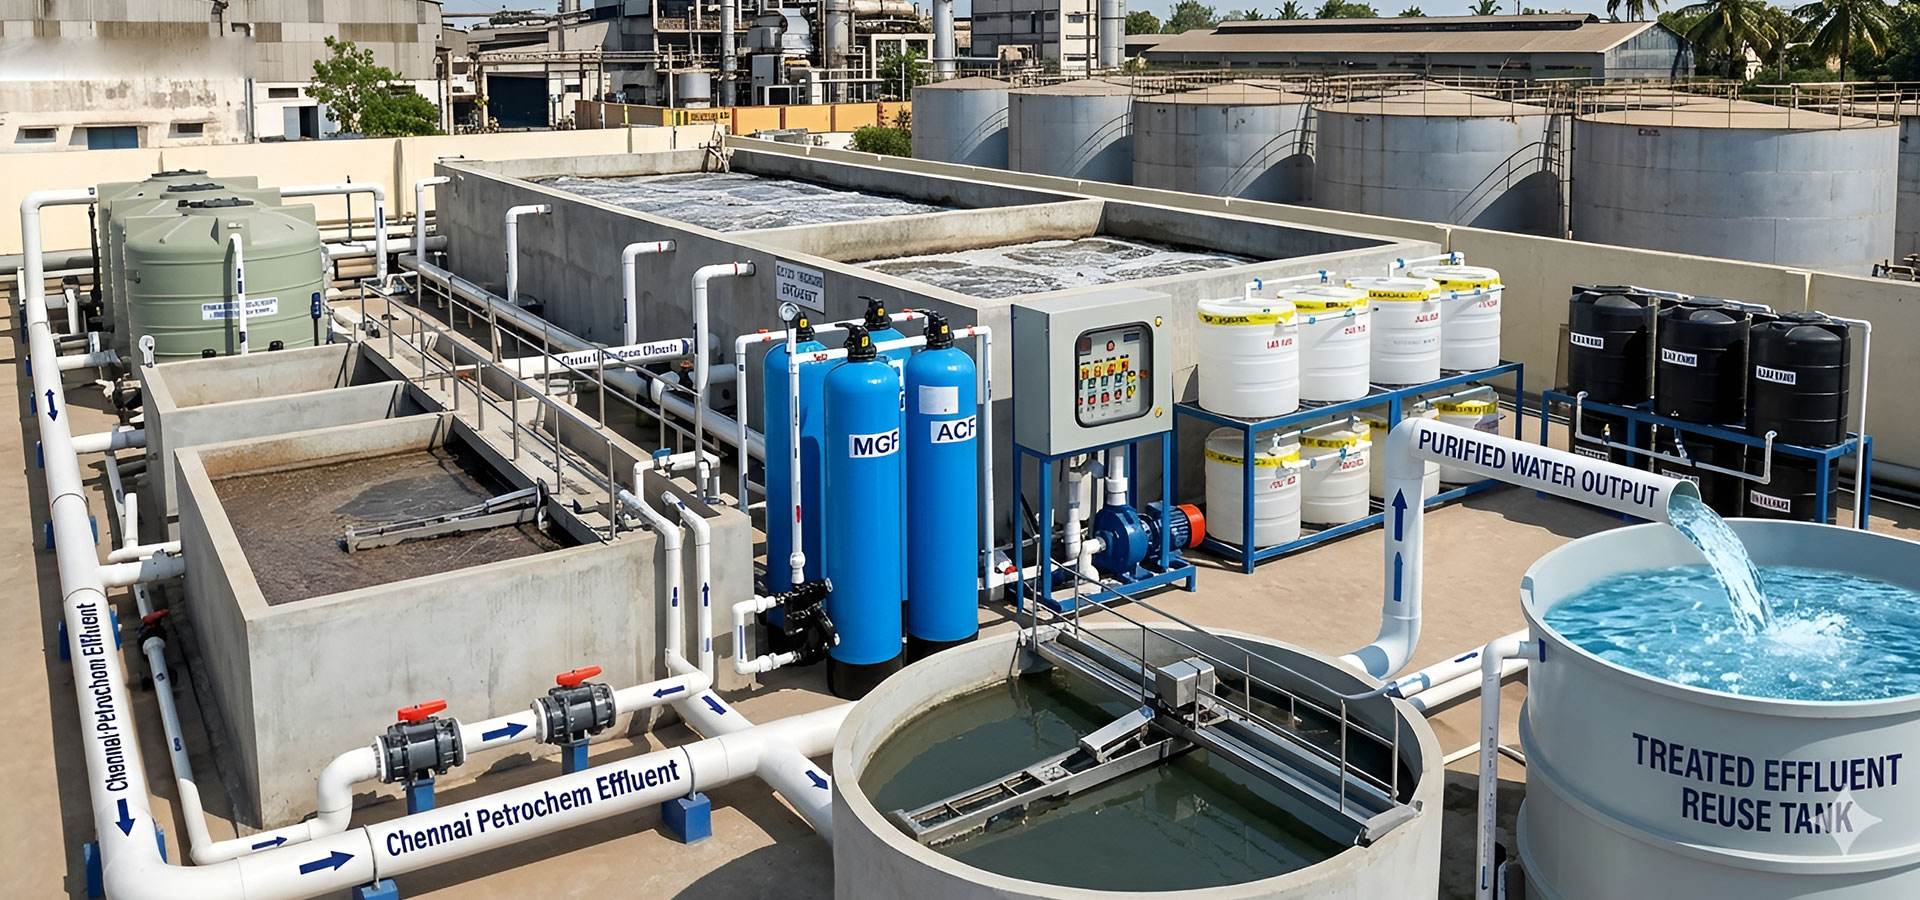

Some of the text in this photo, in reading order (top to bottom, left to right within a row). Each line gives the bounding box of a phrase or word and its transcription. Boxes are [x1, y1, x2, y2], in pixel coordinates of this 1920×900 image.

[854, 431, 899, 456] MGF
[936, 417, 976, 442] ACF
[1418, 428, 1506, 470] PURIFIED
[1511, 450, 1576, 489] WATER
[1581, 470, 1660, 508] OUTPUT
[1632, 732, 1903, 793] TREATED EFFLUENT
[386, 759, 681, 857] Chennai Petrochem Effluent
[1681, 786, 1854, 834] REUSE TANK
